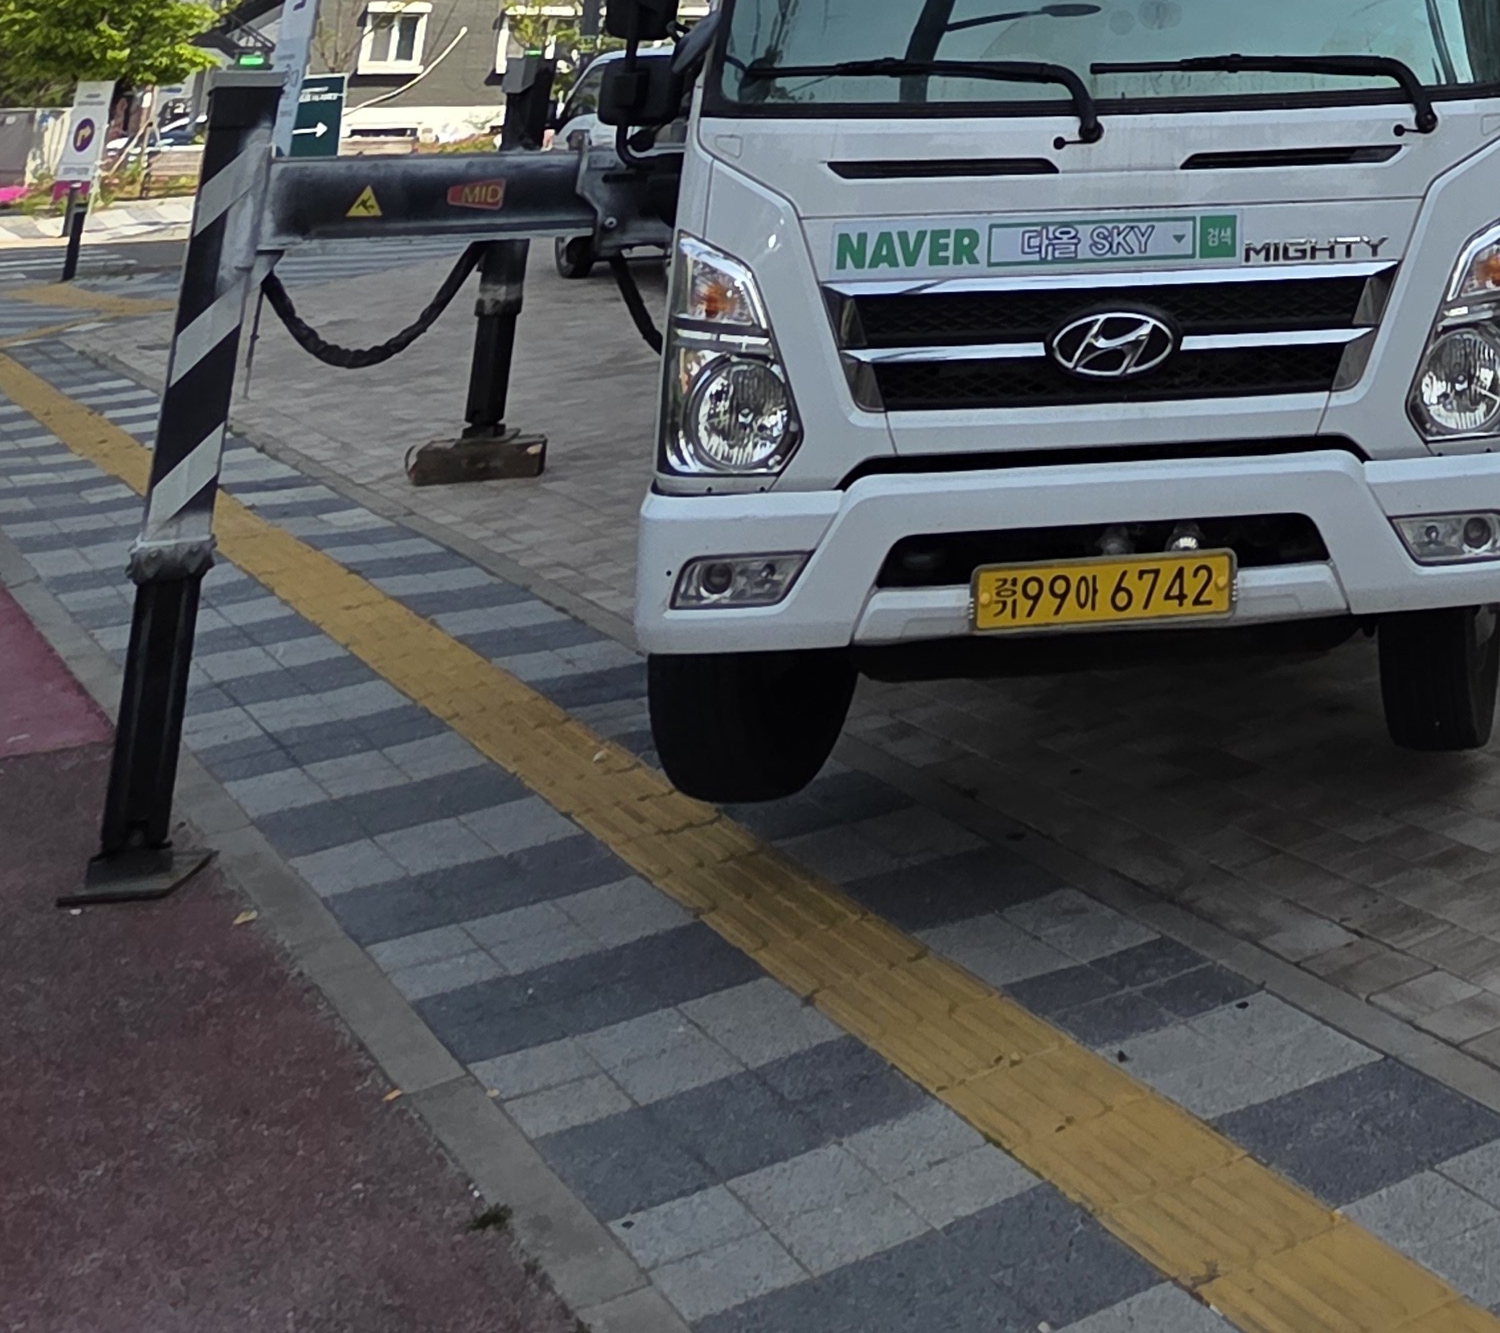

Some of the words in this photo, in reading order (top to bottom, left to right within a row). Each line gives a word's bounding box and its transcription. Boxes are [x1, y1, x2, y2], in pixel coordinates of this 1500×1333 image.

[463, 184, 502, 203] MID
[835, 229, 980, 271] NAVER
[1020, 225, 1082, 261] 다올
[1089, 224, 1157, 255] SKY
[1206, 226, 1232, 247] 검색
[1243, 235, 1388, 264] MIGHTY
[1110, 564, 1214, 612] 6742
